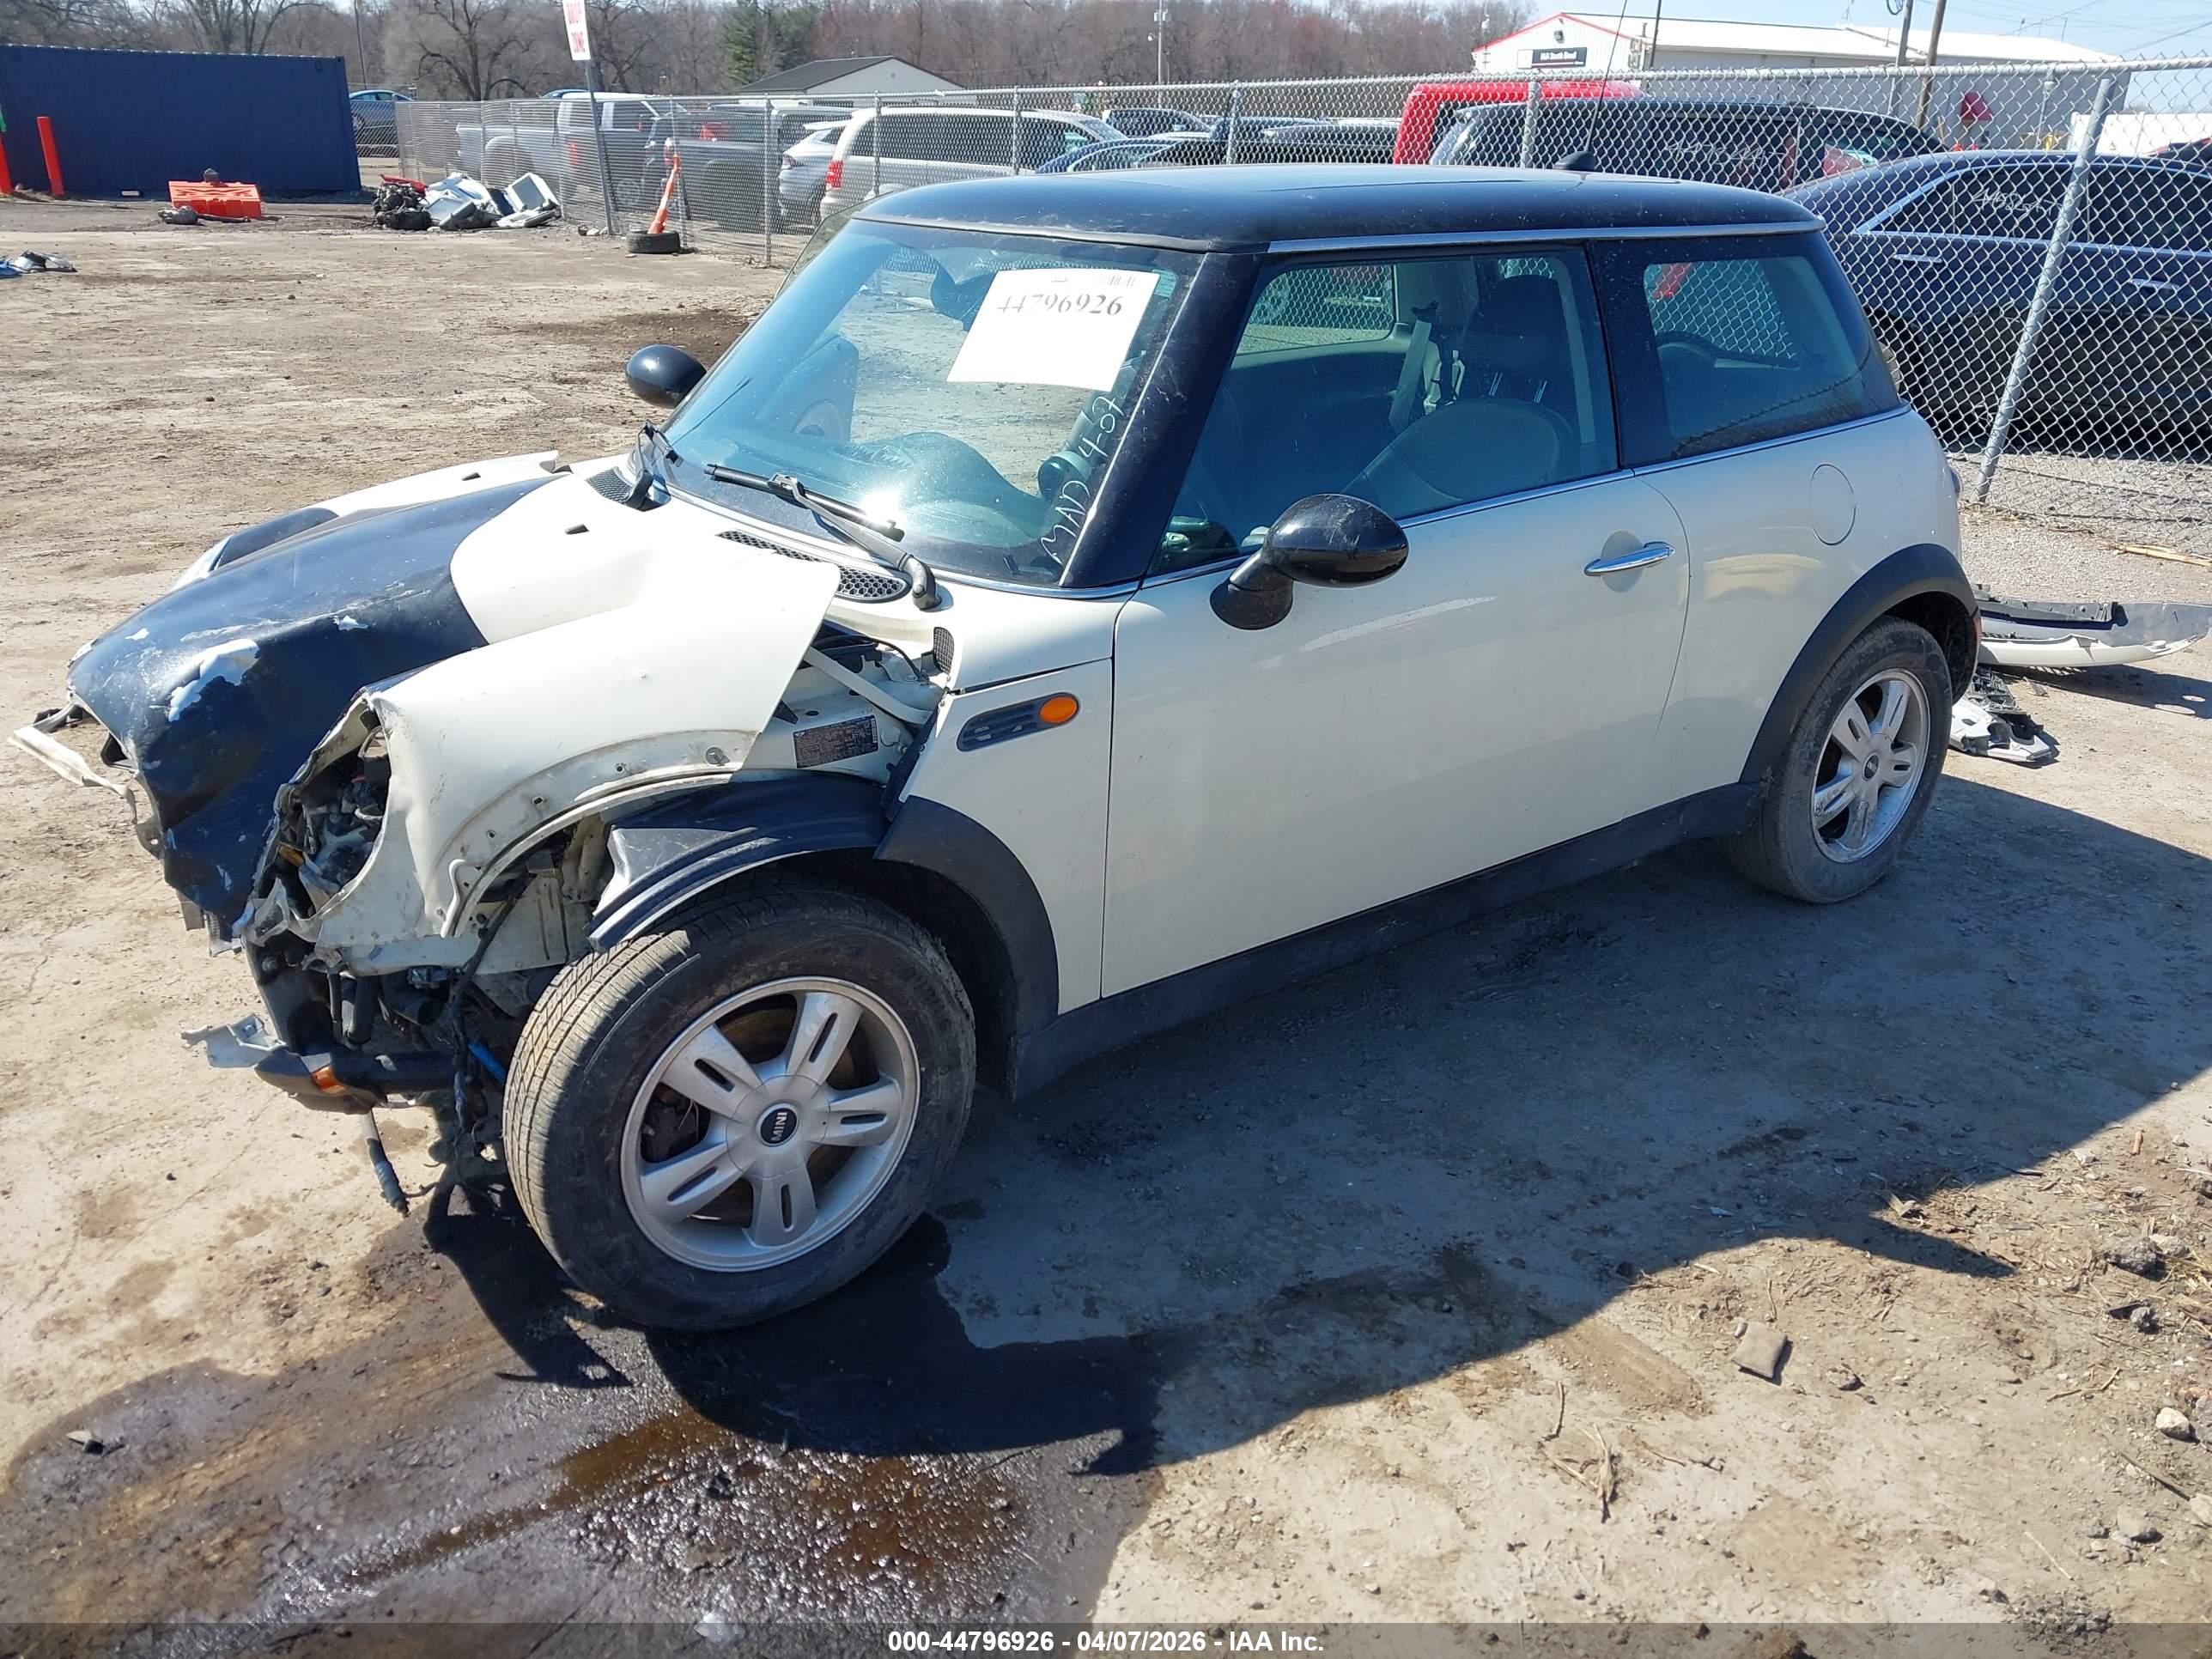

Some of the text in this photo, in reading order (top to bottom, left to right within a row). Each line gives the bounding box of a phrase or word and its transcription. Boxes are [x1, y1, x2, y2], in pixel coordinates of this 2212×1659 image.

[996, 294, 1125, 315] 44796926
[1040, 480, 1091, 566] MAD
[771, 1111, 787, 1141] MINI
